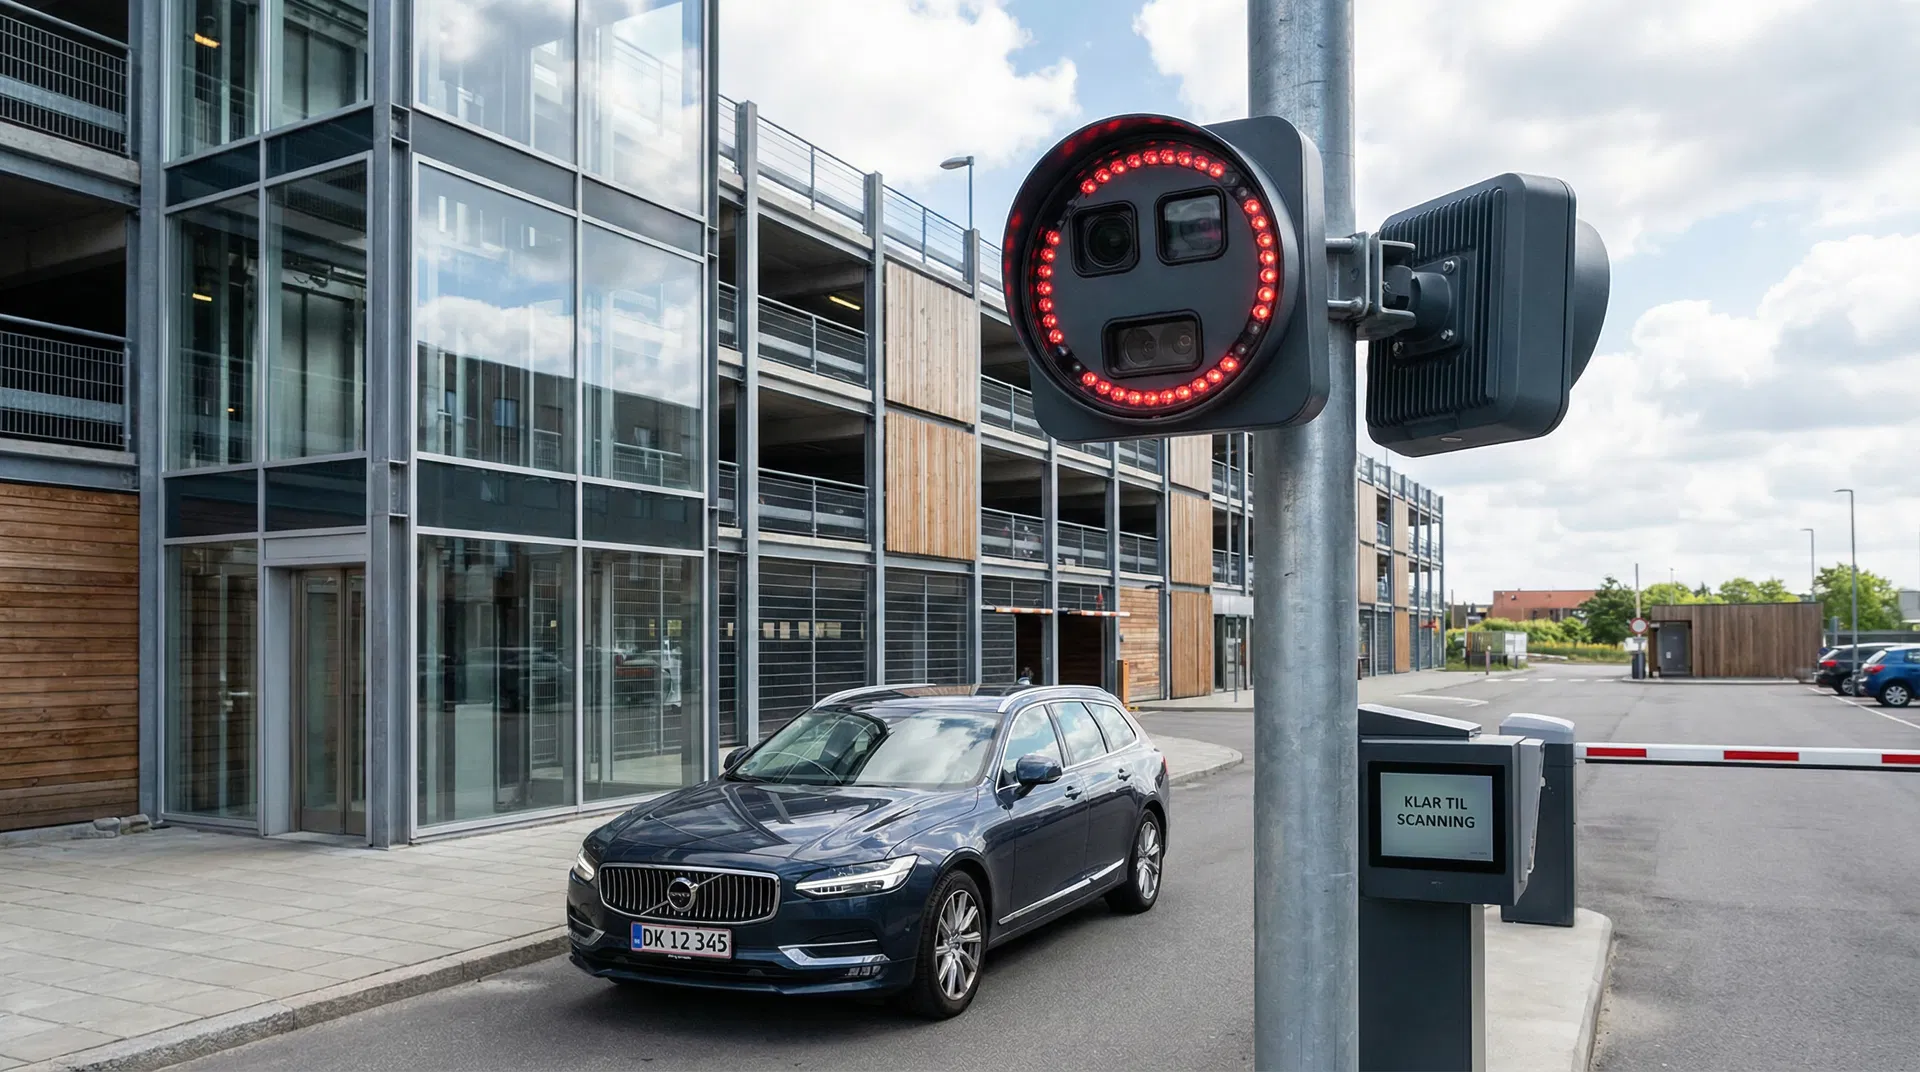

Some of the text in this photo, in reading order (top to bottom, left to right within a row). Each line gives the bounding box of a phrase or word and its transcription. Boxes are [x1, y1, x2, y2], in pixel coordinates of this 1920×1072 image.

[1404, 795, 1468, 810] KLAR TIL
[1397, 813, 1476, 829] SCANNING
[643, 928, 728, 953] DK 12 345
